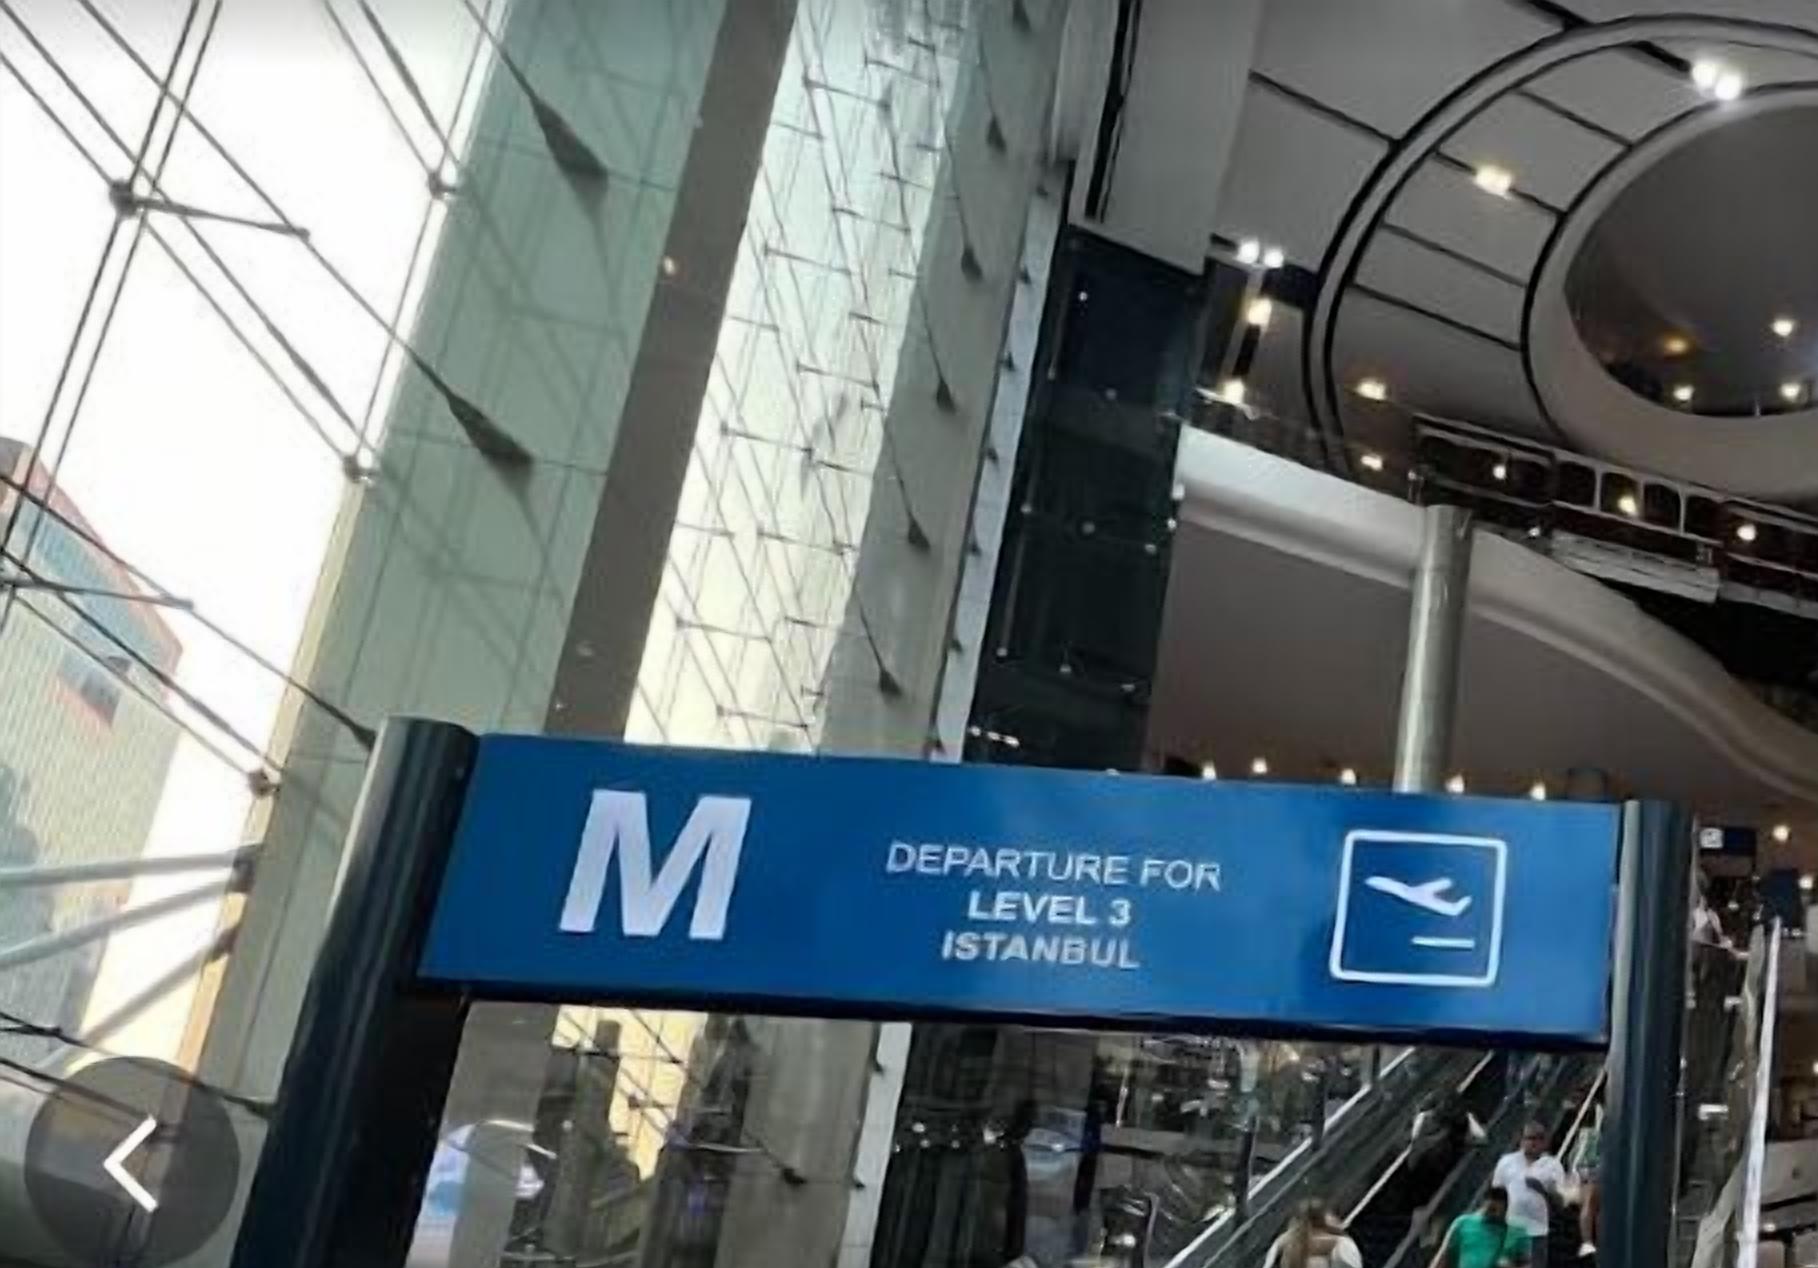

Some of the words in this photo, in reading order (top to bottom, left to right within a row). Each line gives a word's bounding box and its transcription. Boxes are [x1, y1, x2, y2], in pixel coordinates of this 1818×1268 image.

[557, 790, 754, 940] M
[885, 840, 1130, 888] DEPARTURE
[1139, 859, 1222, 893] FOR
[966, 889, 1100, 927] LEVEL
[1107, 898, 1133, 928] 3
[939, 929, 1142, 971] ISTANBUL
